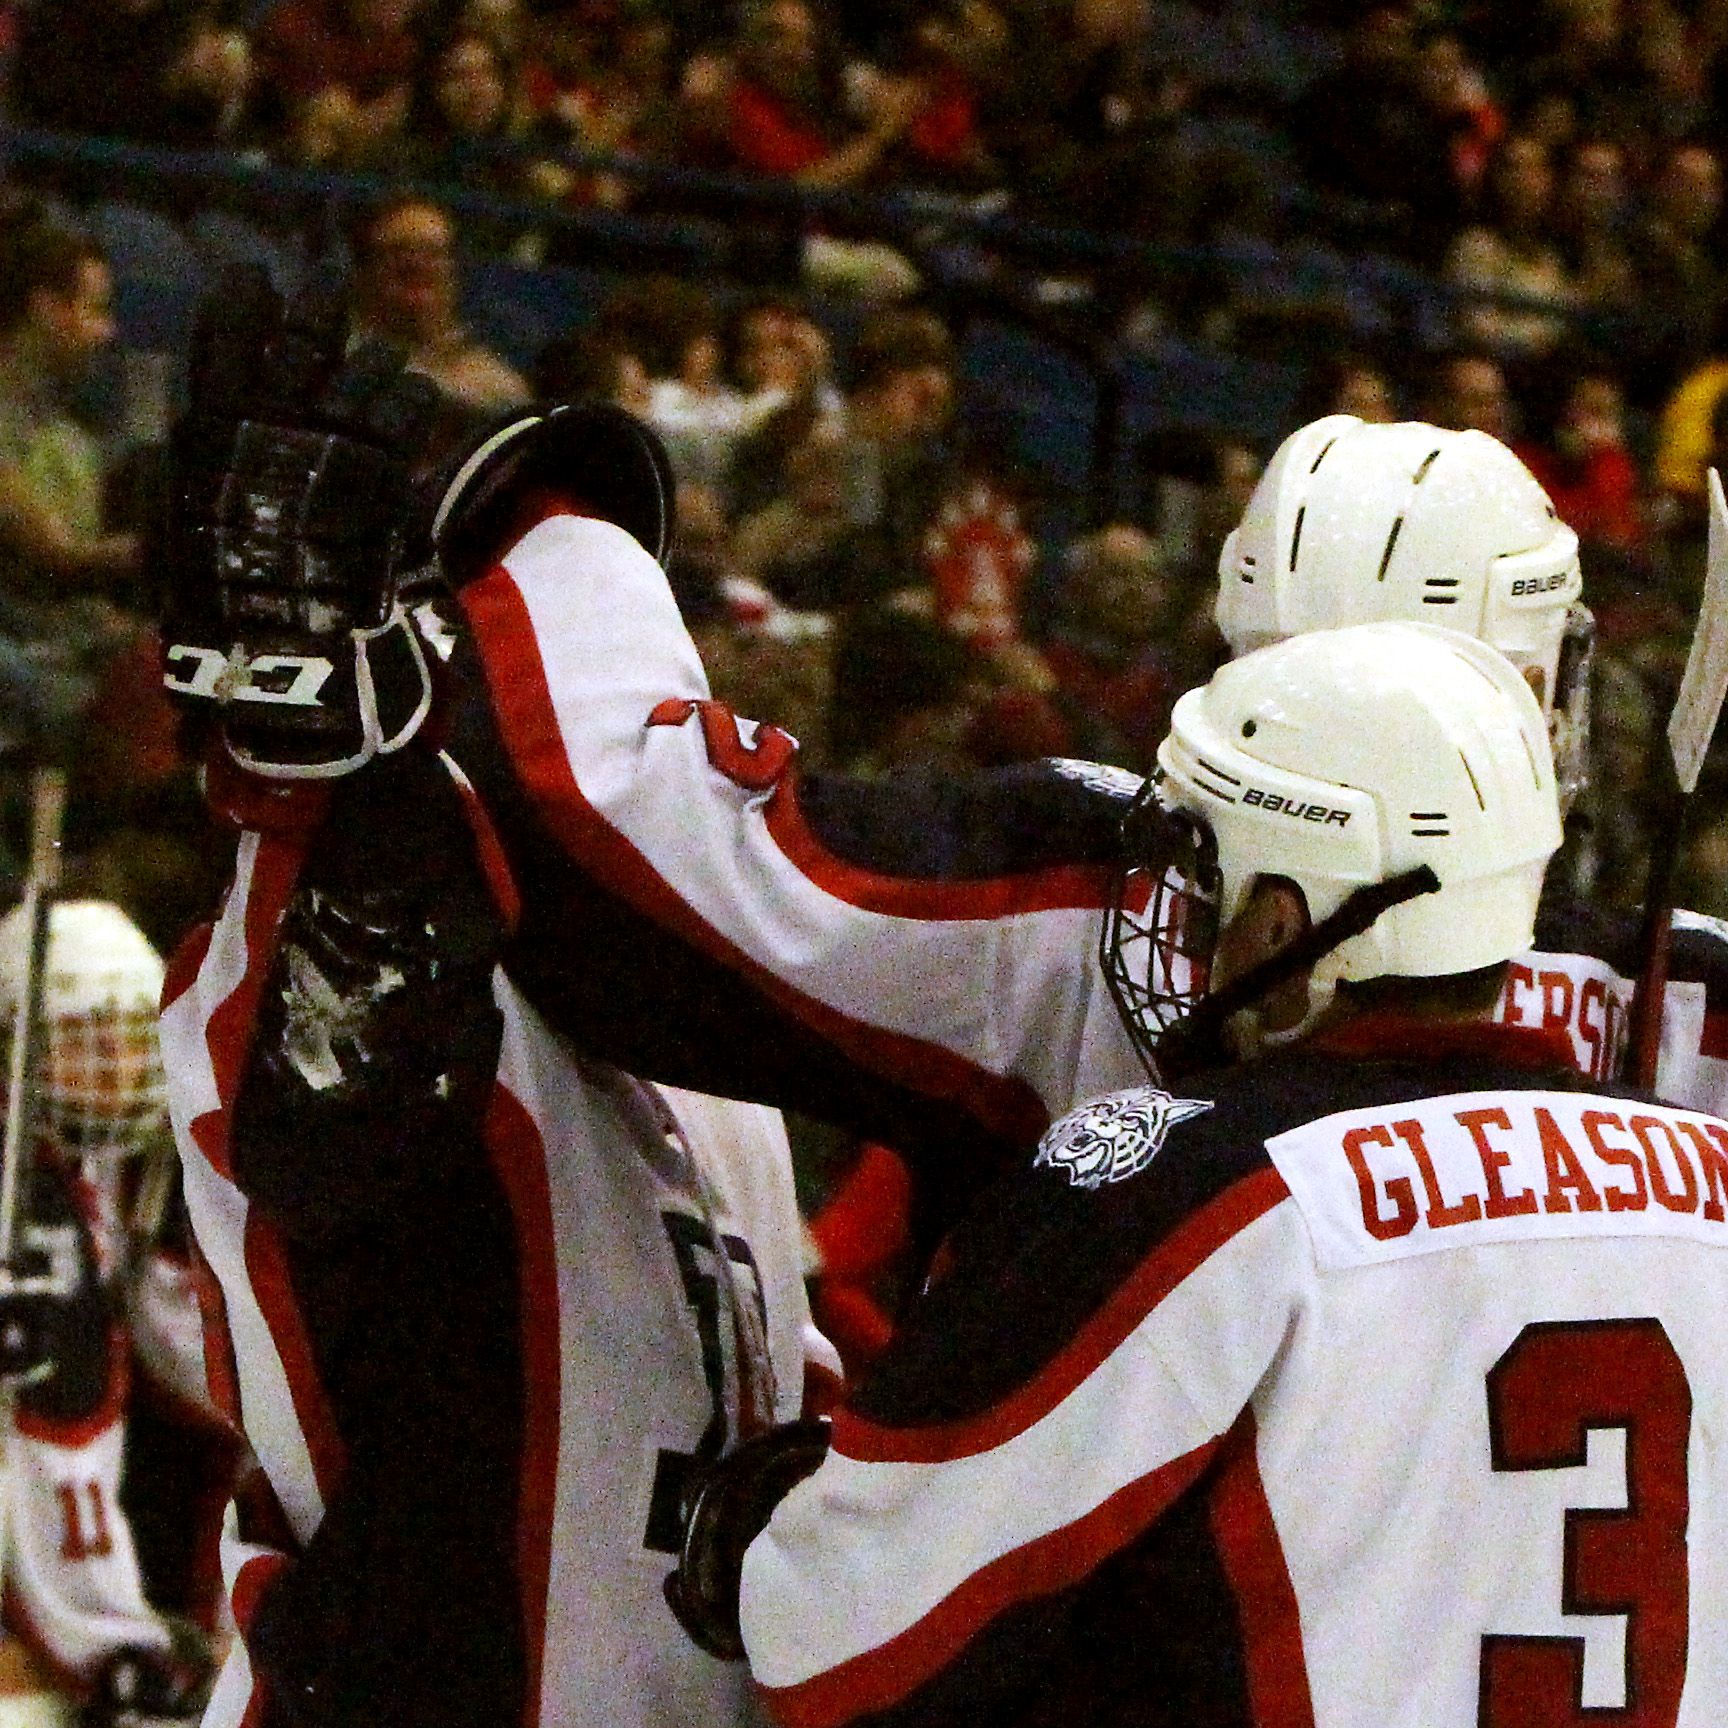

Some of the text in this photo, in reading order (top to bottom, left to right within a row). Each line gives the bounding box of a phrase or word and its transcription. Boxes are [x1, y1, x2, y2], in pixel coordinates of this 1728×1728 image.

[1511, 571, 1568, 596] BAUER
[1241, 787, 1352, 828] BAUER
[55, 1480, 113, 1562] 11
